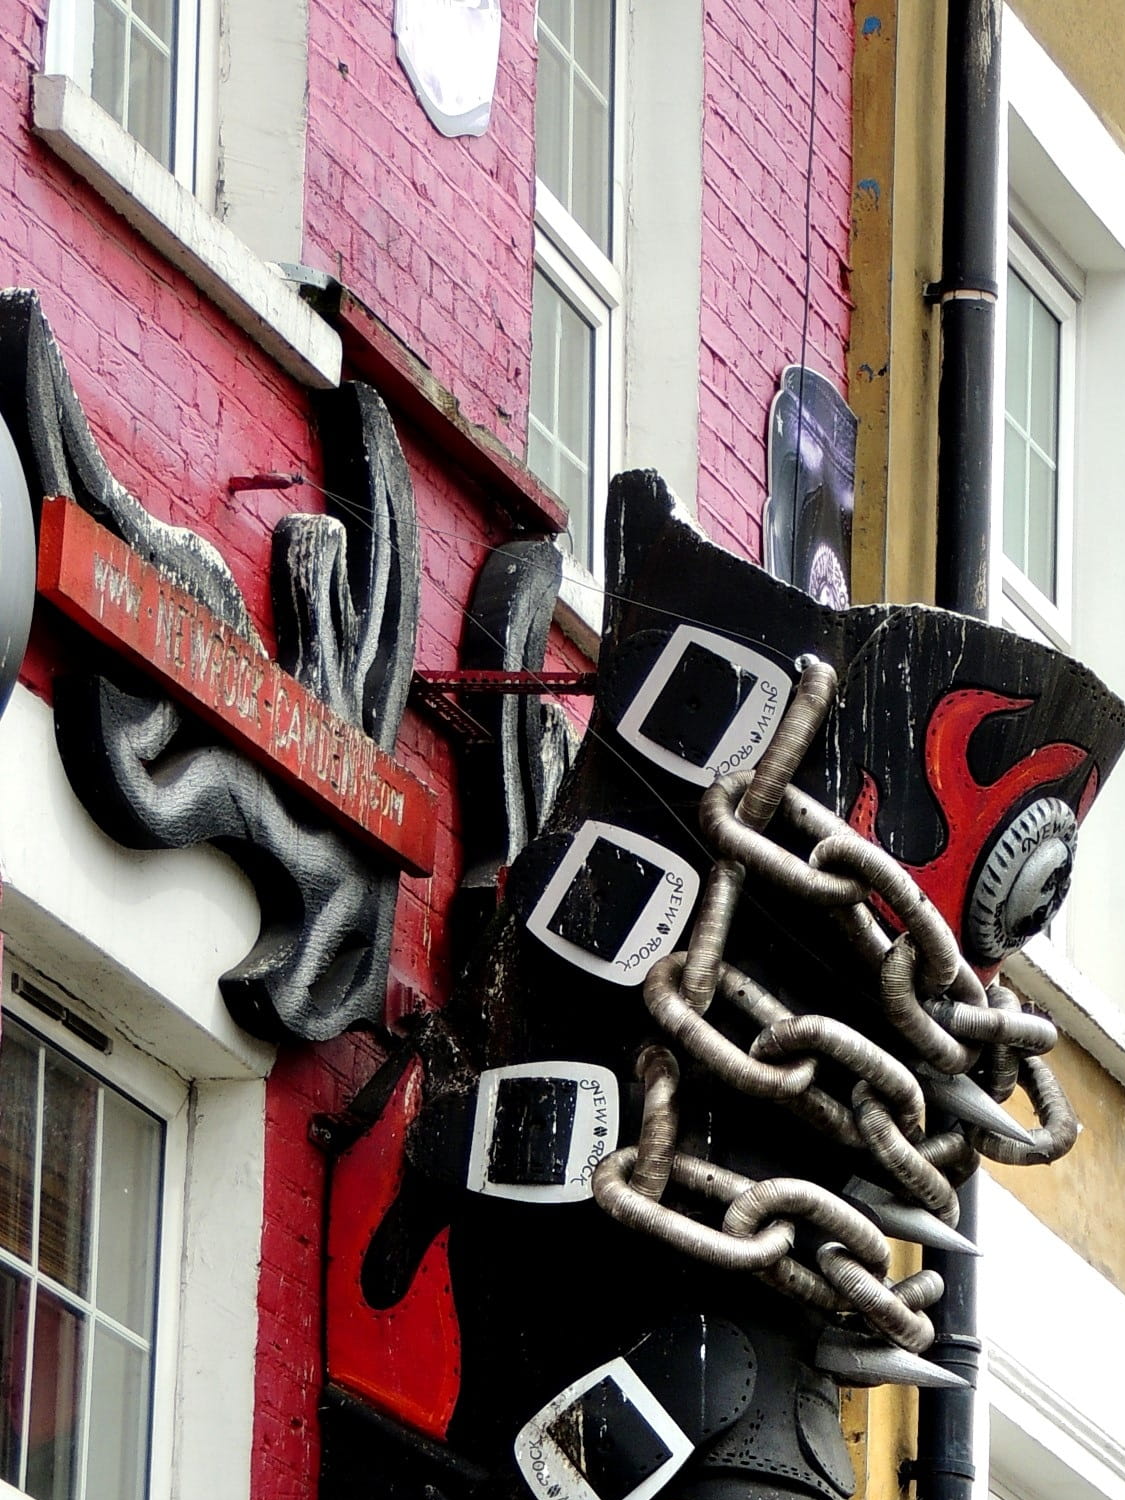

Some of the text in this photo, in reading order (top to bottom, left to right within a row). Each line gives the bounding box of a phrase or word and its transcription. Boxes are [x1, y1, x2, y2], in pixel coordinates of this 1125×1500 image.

[706, 680, 778, 778] NEW ROCK
[1022, 820, 1067, 853] NEW
[615, 871, 685, 973] NEW ROCK
[570, 1079, 608, 1186] NEW ROCK
[529, 1434, 550, 1487] ROCK
